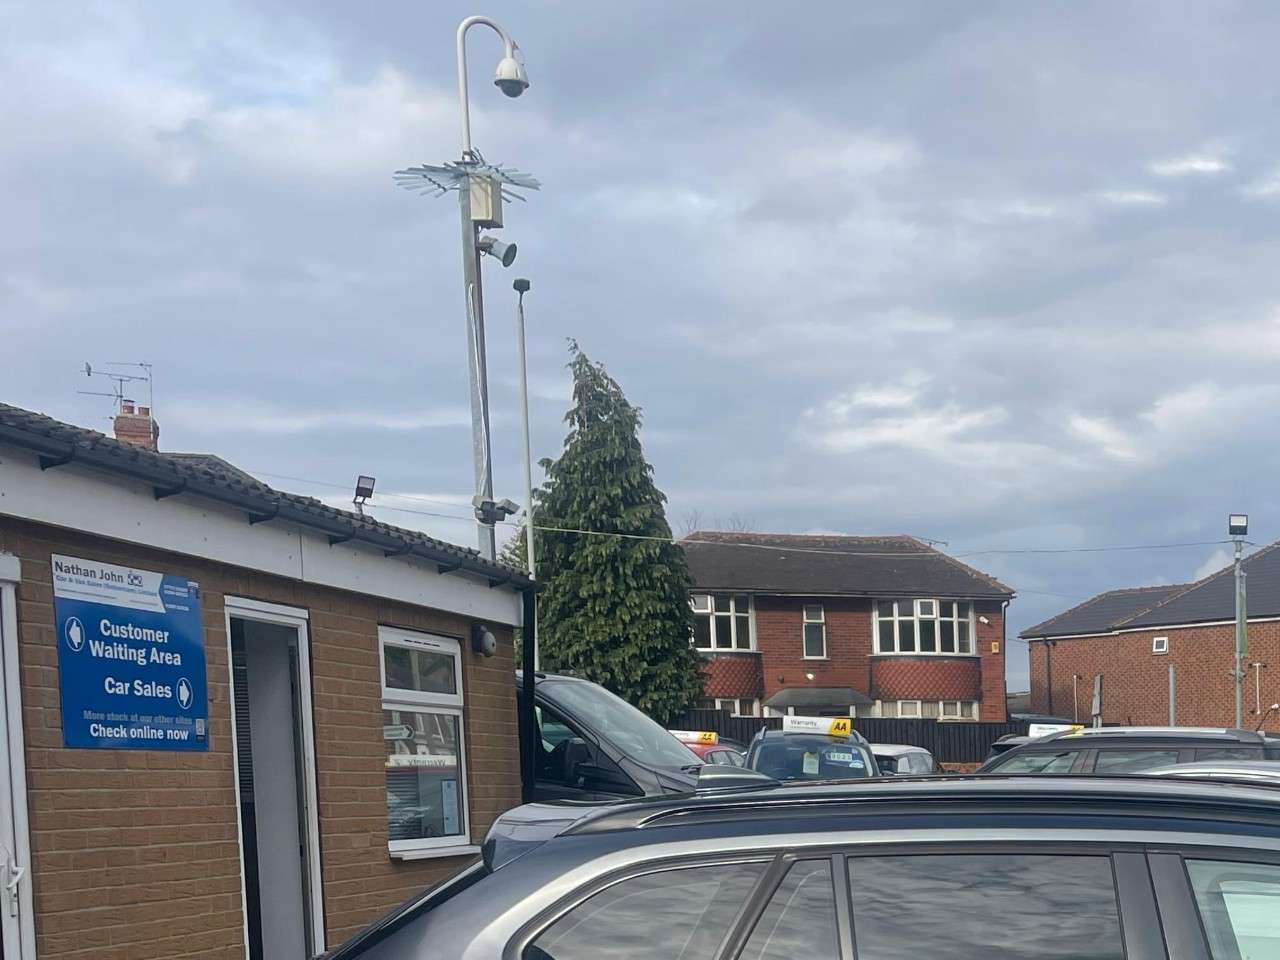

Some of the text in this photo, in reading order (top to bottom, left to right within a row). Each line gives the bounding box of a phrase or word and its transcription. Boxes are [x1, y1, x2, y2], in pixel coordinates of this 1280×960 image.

[54, 560, 124, 583] Nathan John
[100, 619, 169, 643] Customer
[89, 639, 181, 666] Waiting Area
[104, 677, 172, 698] Car Sales
[83, 709, 105, 720] More
[790, 719, 847, 731] Warranty AA
[90, 723, 189, 740] Check online now
